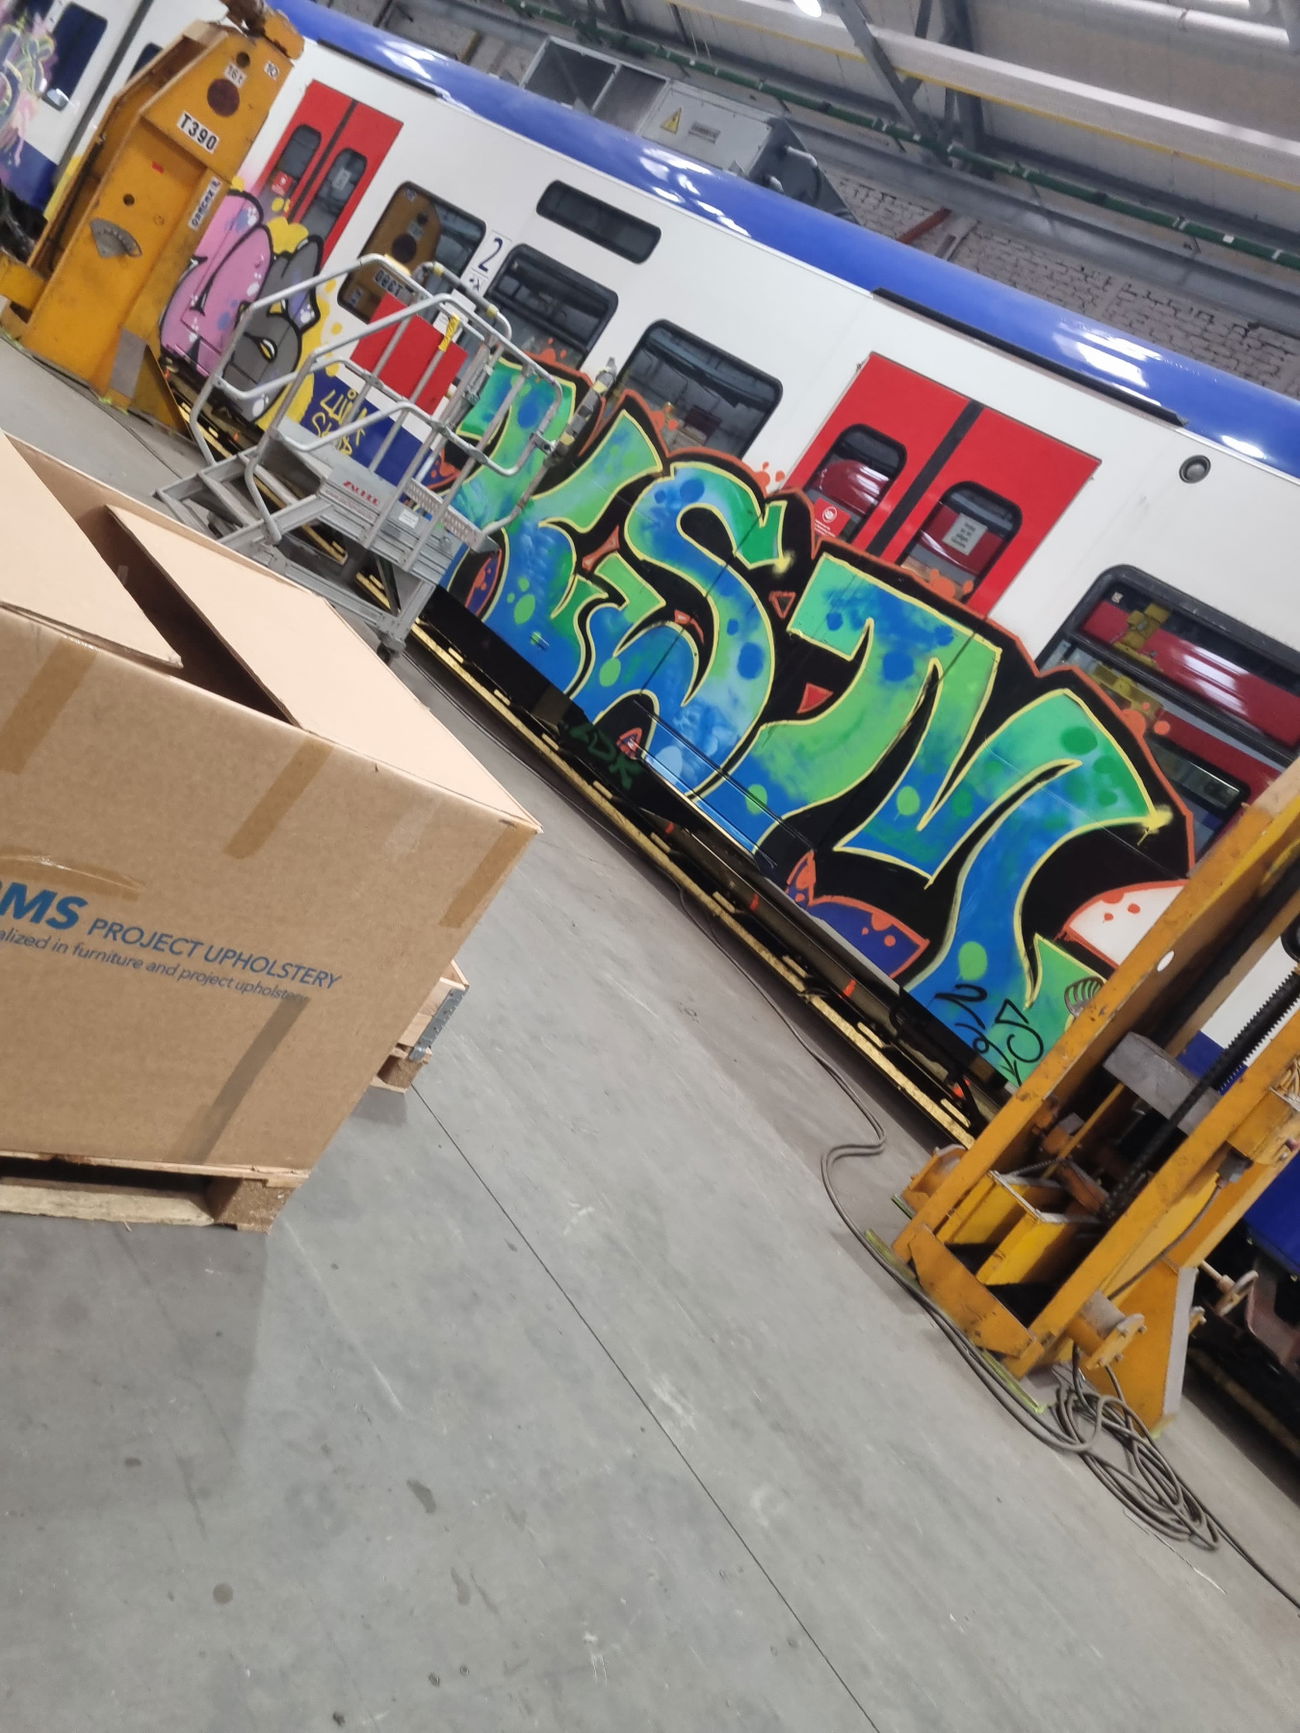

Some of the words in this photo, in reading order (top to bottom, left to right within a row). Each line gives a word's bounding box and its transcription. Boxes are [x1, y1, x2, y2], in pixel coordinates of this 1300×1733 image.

[180, 113, 218, 151] T390
[478, 237, 503, 272] 2
[0, 881, 88, 930] MS
[87, 918, 204, 958] PROJECT
[204, 945, 343, 989] UPHOLSTERY
[52, 938, 69, 953] in
[72, 942, 144, 969] furniture
[146, 959, 179, 977] and
[176, 969, 234, 987] project
